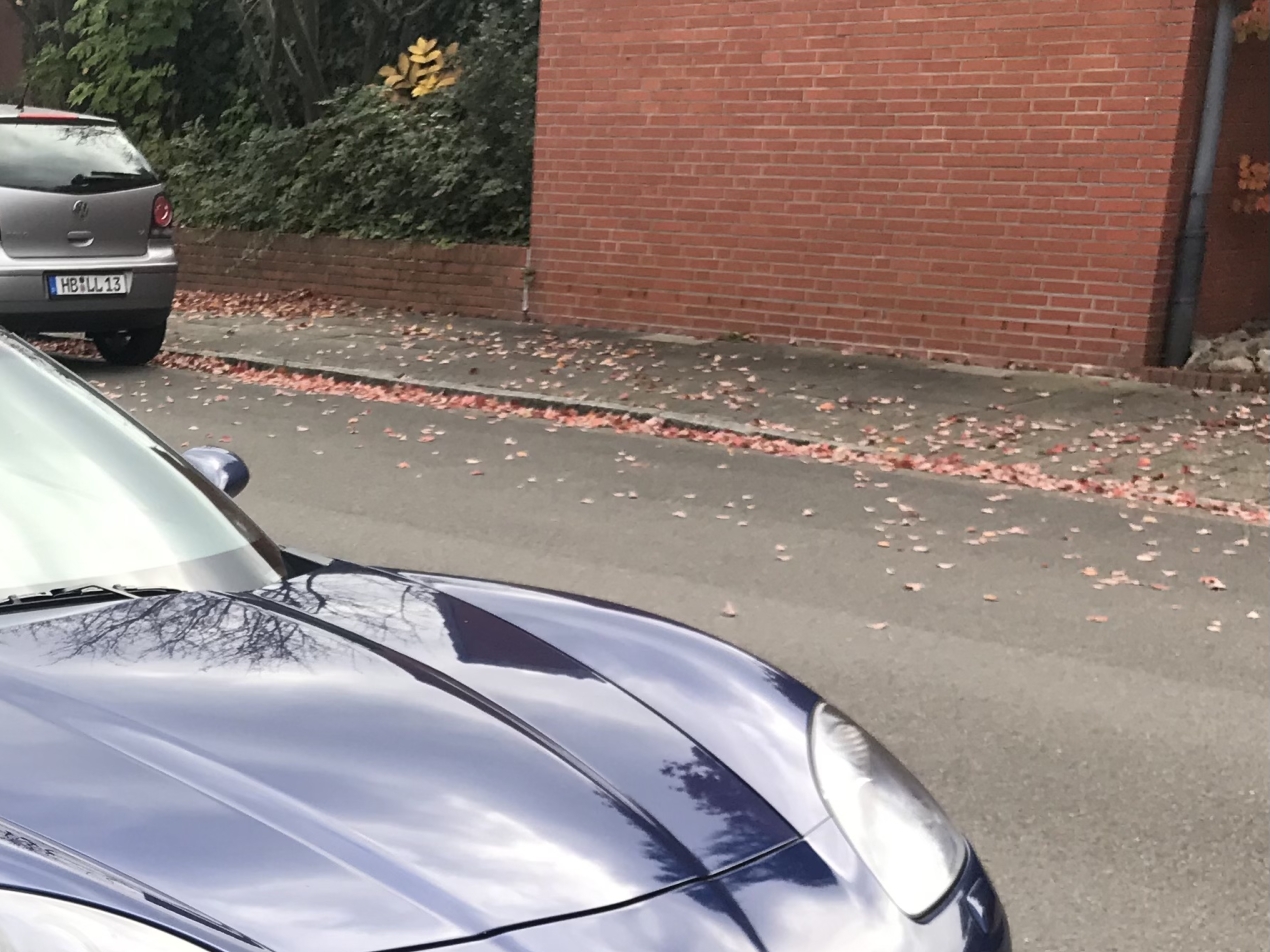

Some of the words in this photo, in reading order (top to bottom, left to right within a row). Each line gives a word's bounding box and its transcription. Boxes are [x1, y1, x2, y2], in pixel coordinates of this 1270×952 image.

[60, 277, 78, 293] HB
[87, 277, 103, 293] LL
[105, 276, 121, 292] 13
